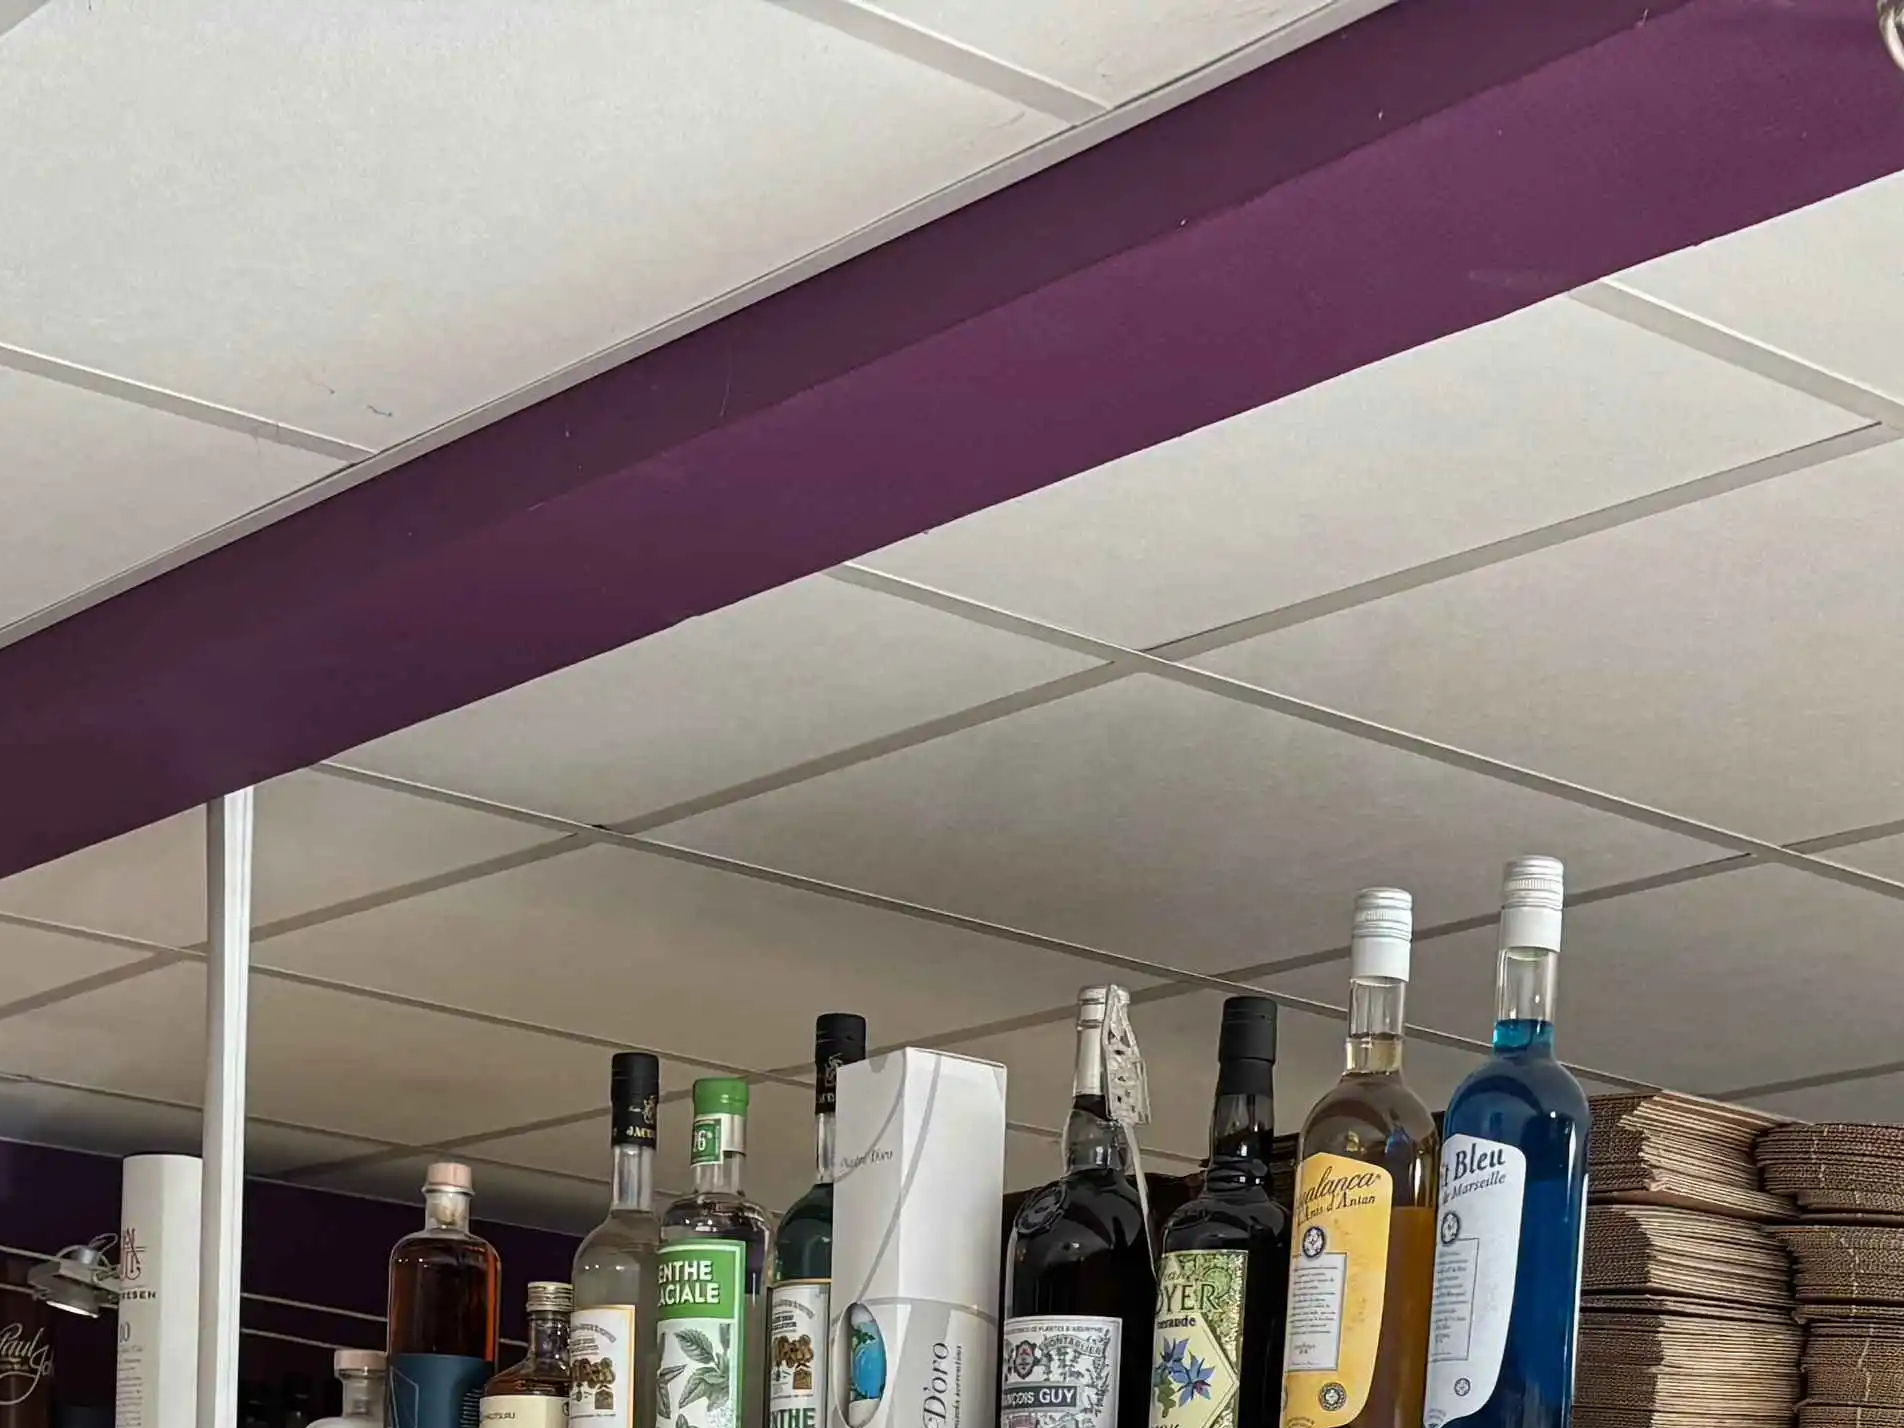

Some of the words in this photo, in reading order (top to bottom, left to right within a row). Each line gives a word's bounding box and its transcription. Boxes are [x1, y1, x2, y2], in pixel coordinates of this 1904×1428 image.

[1453, 1143, 1506, 1181] Bleu
[1453, 1172, 1507, 1203] Marseille
[1039, 1386, 1073, 1406] GUY
